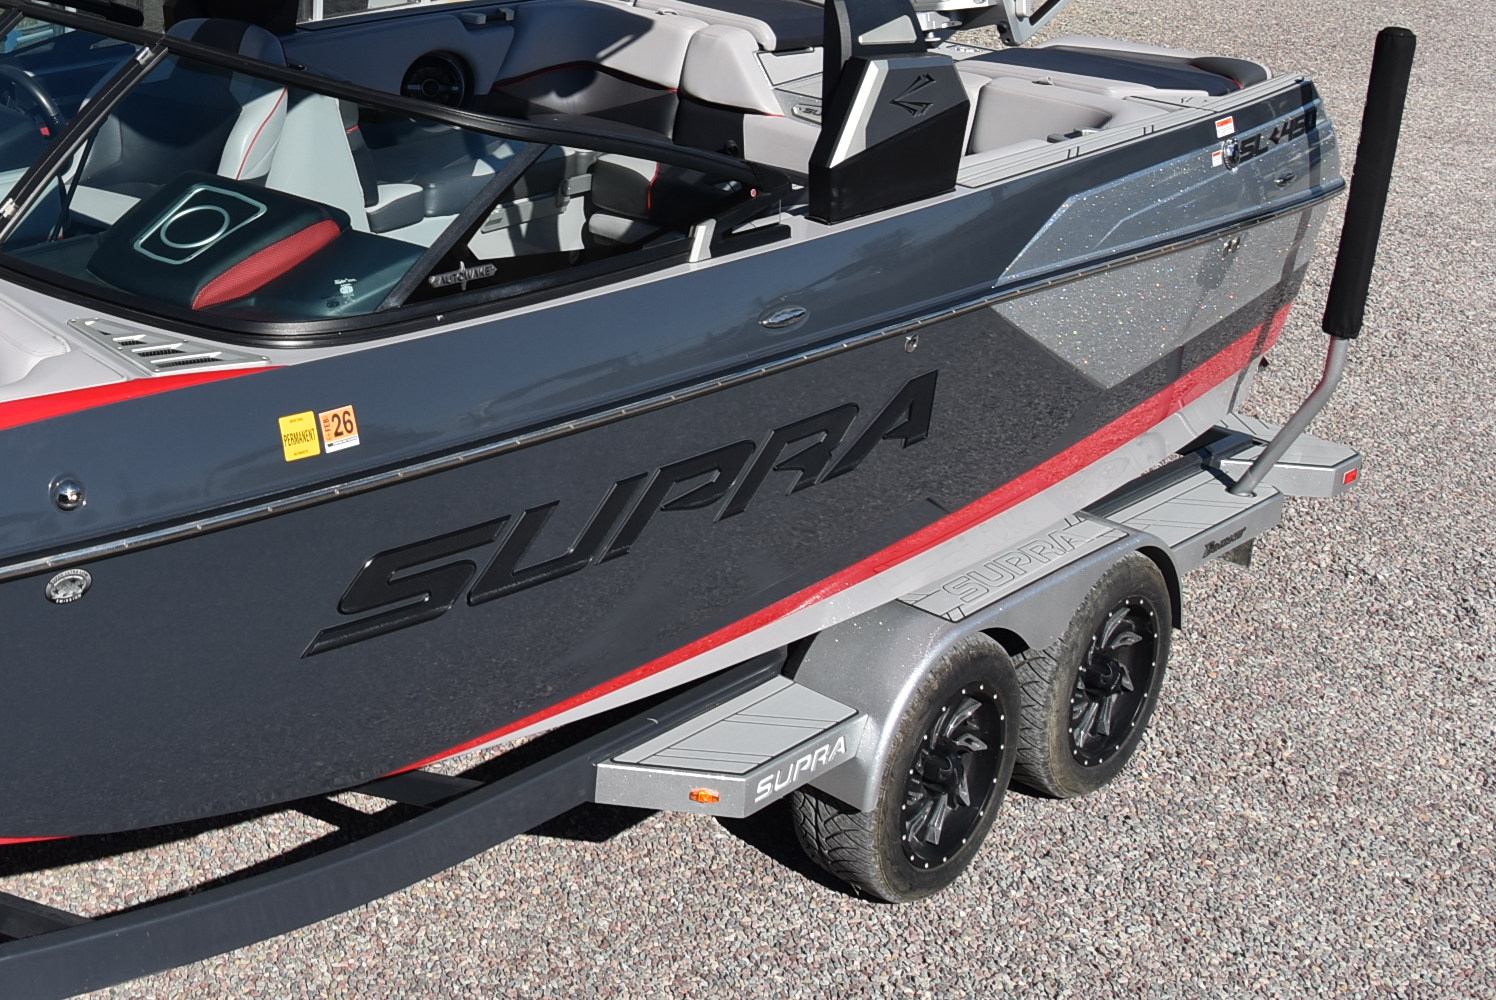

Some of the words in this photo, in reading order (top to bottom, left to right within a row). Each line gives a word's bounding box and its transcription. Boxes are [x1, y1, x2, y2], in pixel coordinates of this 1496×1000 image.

[283, 427, 316, 447] PERMANENT
[332, 409, 354, 438] 26
[300, 370, 938, 659] SUPRA
[942, 530, 1087, 604] SUPRA
[752, 733, 848, 804] SUPRA
